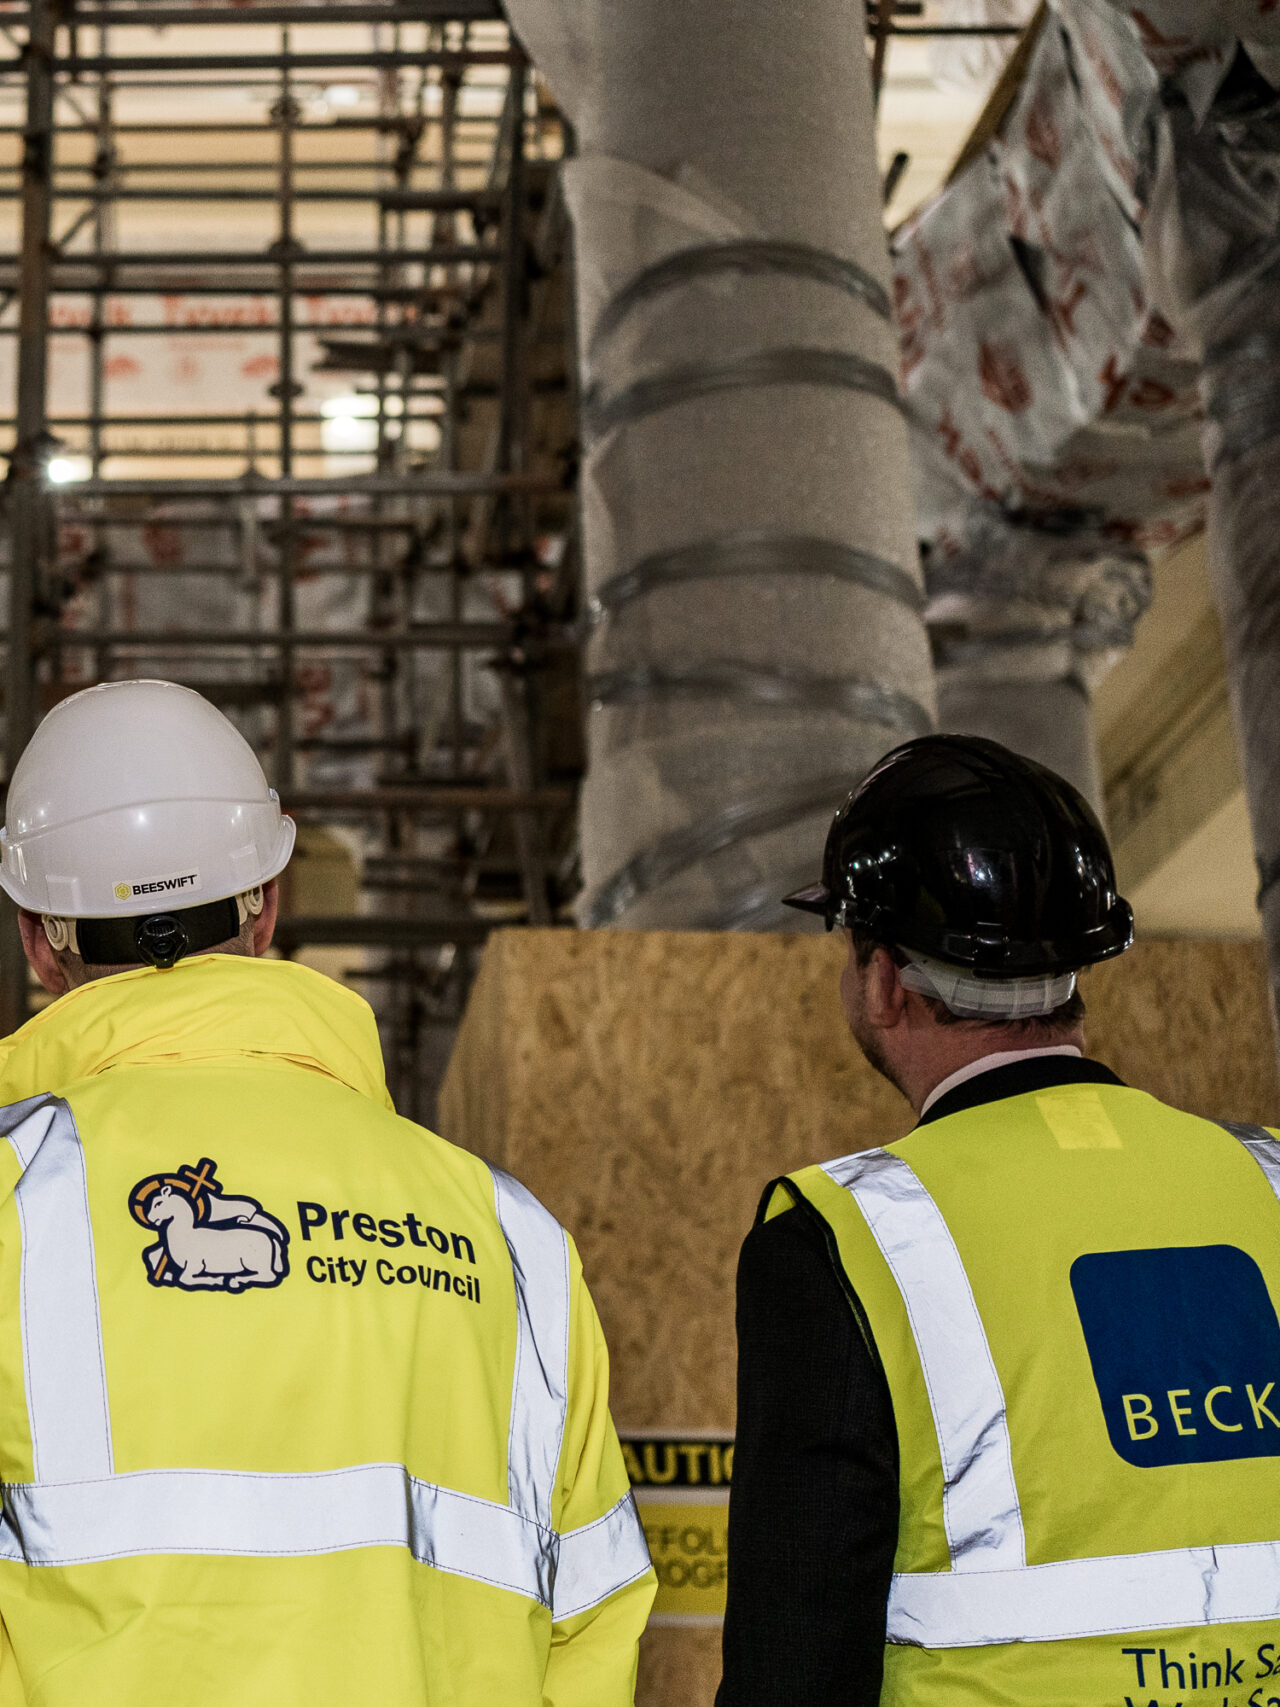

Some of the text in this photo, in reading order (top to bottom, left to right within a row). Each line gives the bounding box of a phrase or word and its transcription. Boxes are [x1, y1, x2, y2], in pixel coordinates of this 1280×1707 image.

[132, 874, 198, 895] BEESWIFT
[297, 1201, 476, 1264] Preston
[306, 1256, 481, 1304] City Council
[1122, 1382, 1280, 1441] BECK
[1122, 1648, 1245, 1689] Think
